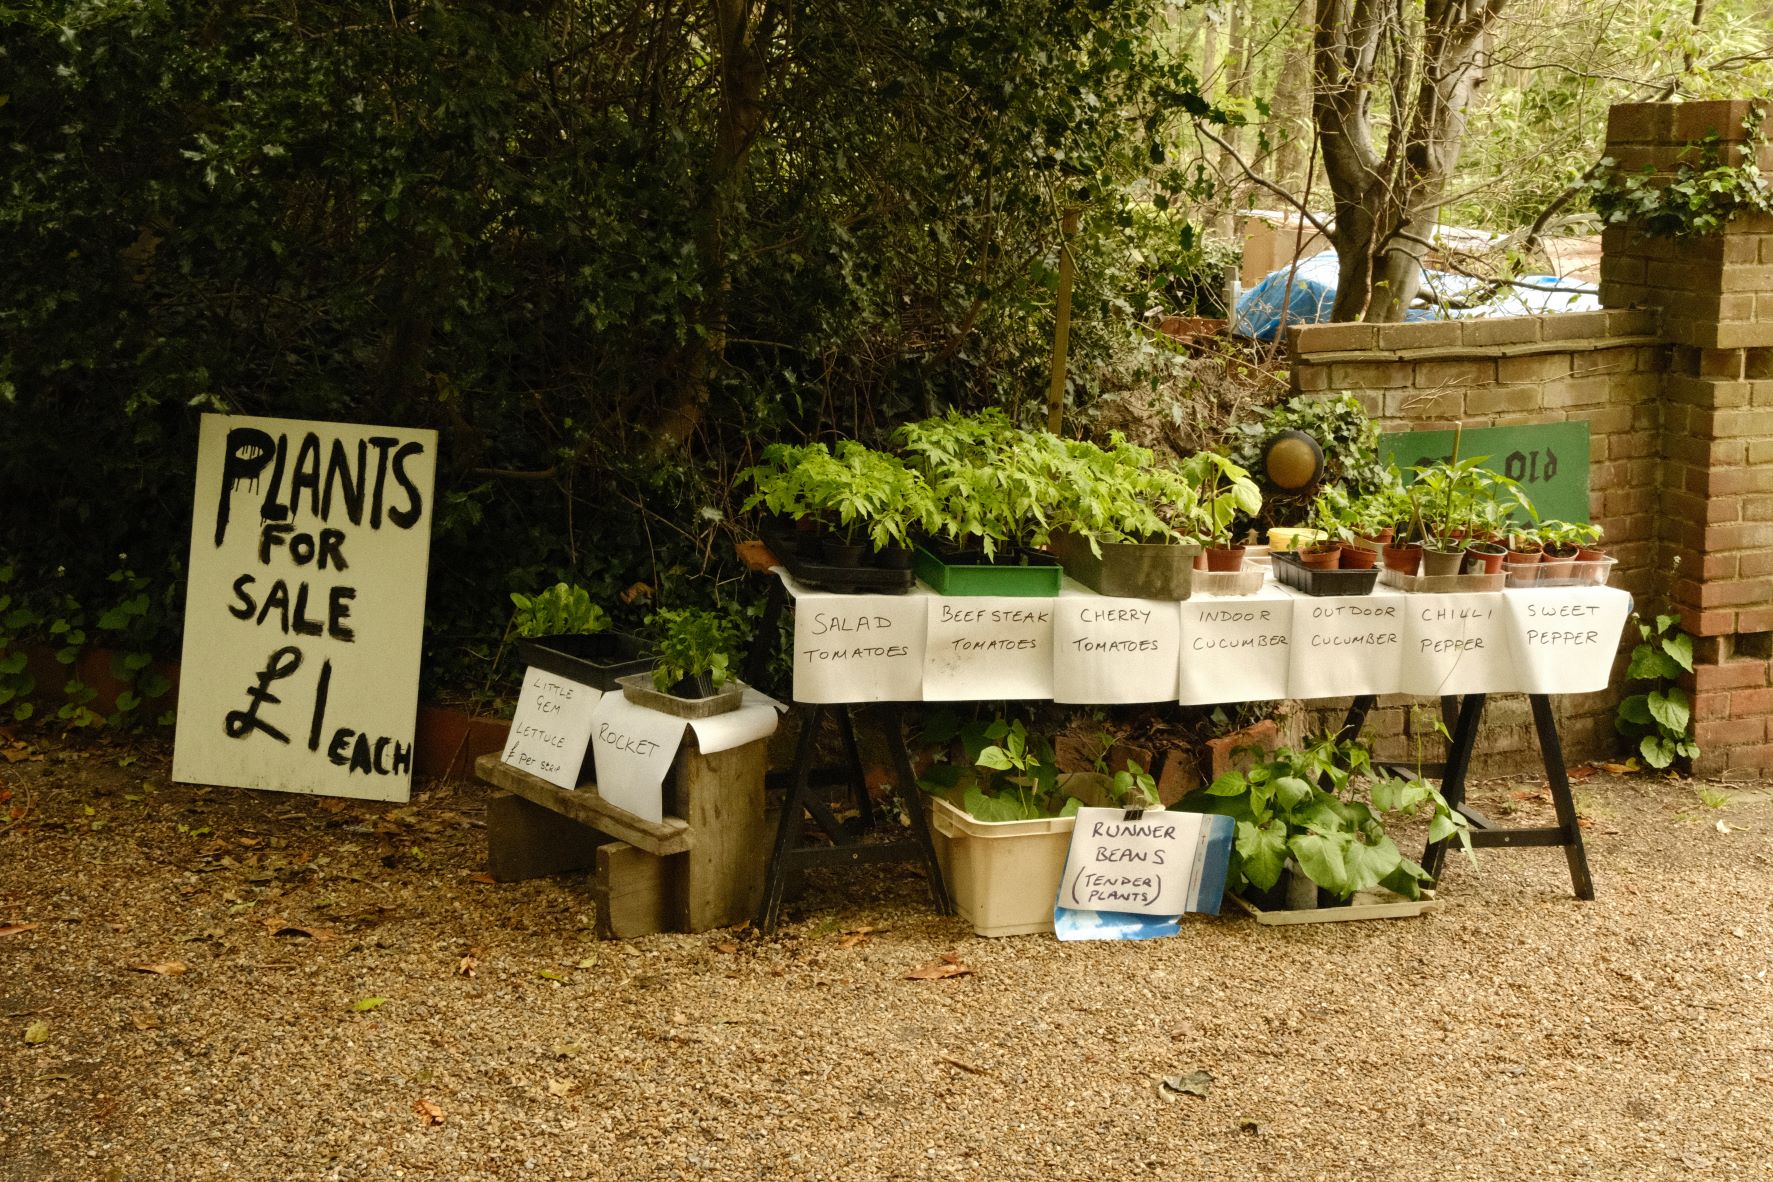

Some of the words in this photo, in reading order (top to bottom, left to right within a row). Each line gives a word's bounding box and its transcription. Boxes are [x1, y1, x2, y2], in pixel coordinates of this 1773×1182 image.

[214, 427, 424, 548] PLANTS
[260, 523, 349, 571] FOR
[228, 574, 356, 643] SALE
[1080, 607, 1151, 624] CHERRY
[1199, 609, 1271, 624] INDOOR
[1312, 606, 1396, 619] OUTDOOR
[1421, 607, 1493, 621] CHILLI
[1528, 604, 1601, 617] SWEET
[811, 612, 892, 635] SALAD
[952, 638, 1037, 651] TOMATOES
[1073, 636, 1159, 652] TOMATOES
[1193, 633, 1289, 651] CUCUMBER
[1311, 632, 1397, 647] CUCUMBER
[1421, 637, 1485, 653] PEPPER
[1527, 629, 1599, 646] PEPPER
[803, 645, 909, 663] TOMATOES
[533, 679, 574, 700] LITTLE
[536, 695, 561, 714] GEM
[516, 721, 565, 748] LETTUCE
[599, 722, 661, 758] ROCKET
[327, 727, 411, 776] EACH
[1092, 821, 1177, 840] RUNNER
[1096, 847, 1165, 865] BEANS
